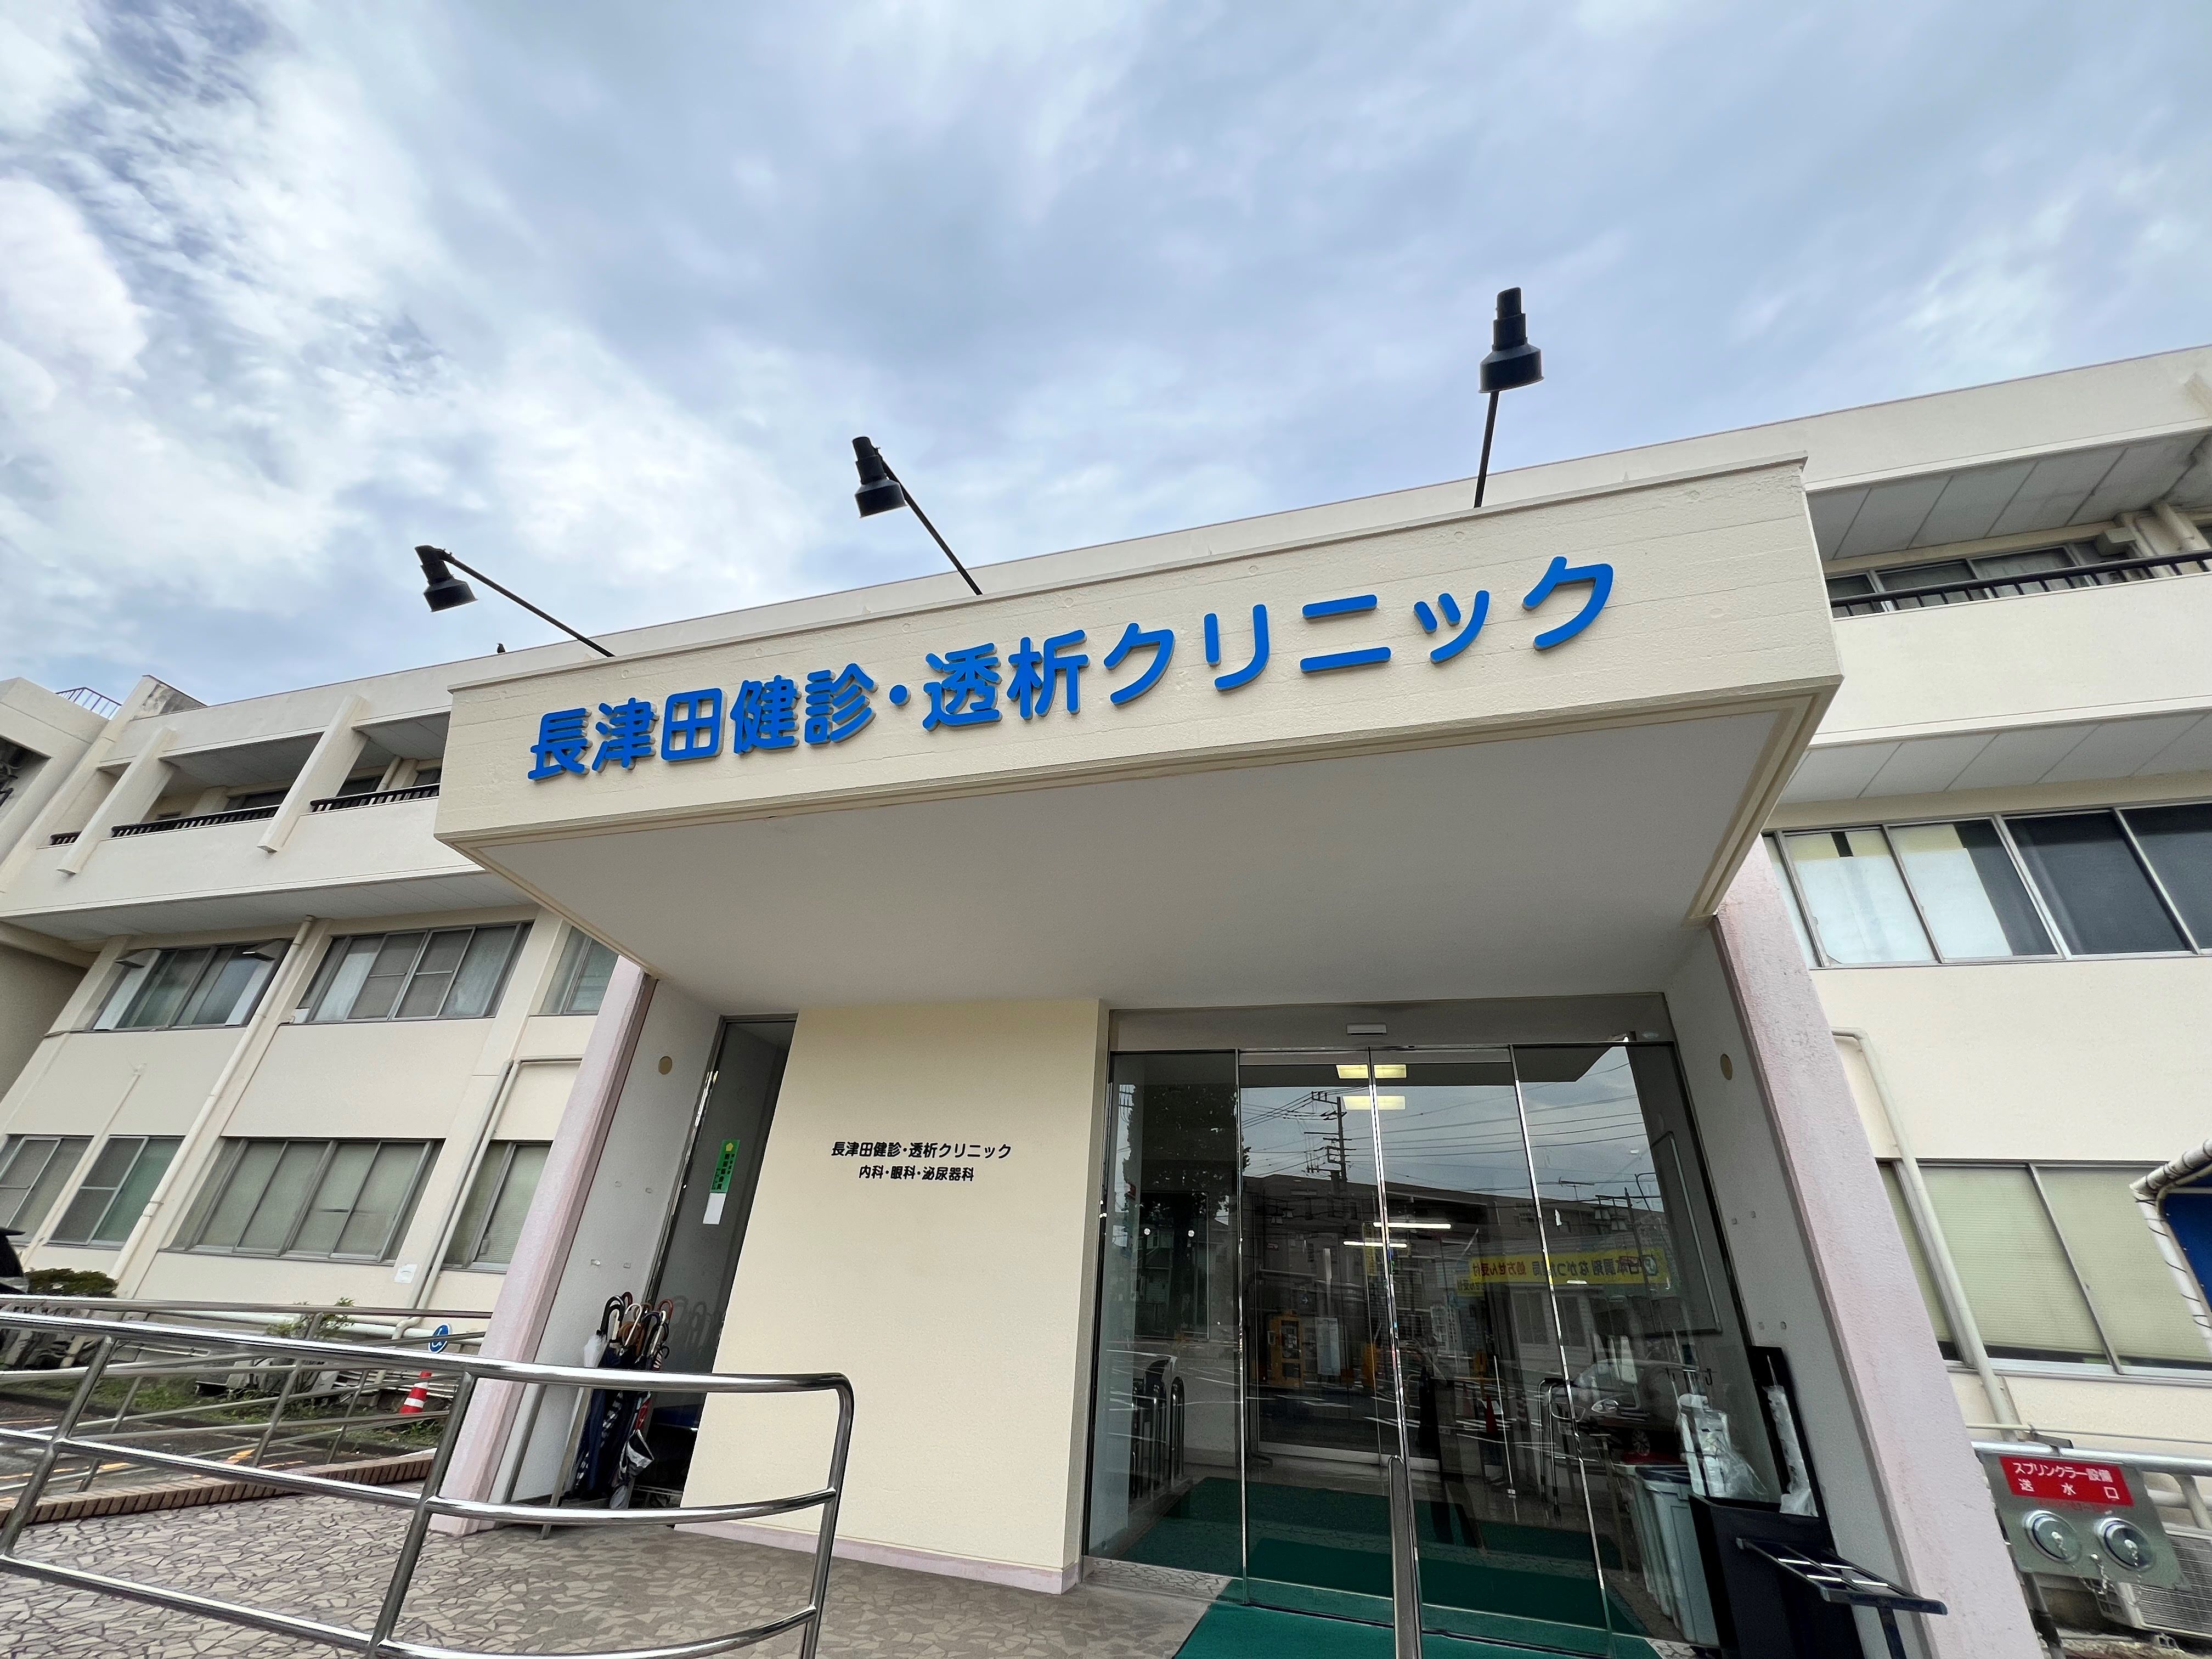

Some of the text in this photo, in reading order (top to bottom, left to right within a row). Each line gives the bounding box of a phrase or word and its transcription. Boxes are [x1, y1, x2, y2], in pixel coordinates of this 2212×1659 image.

[528, 556, 1614, 781] 長津田健診・透析クリニック
[831, 1141, 1011, 1159] 長津田健診・透析クリニック
[859, 1164, 974, 1182] 内科・眼科・泌尿器科
